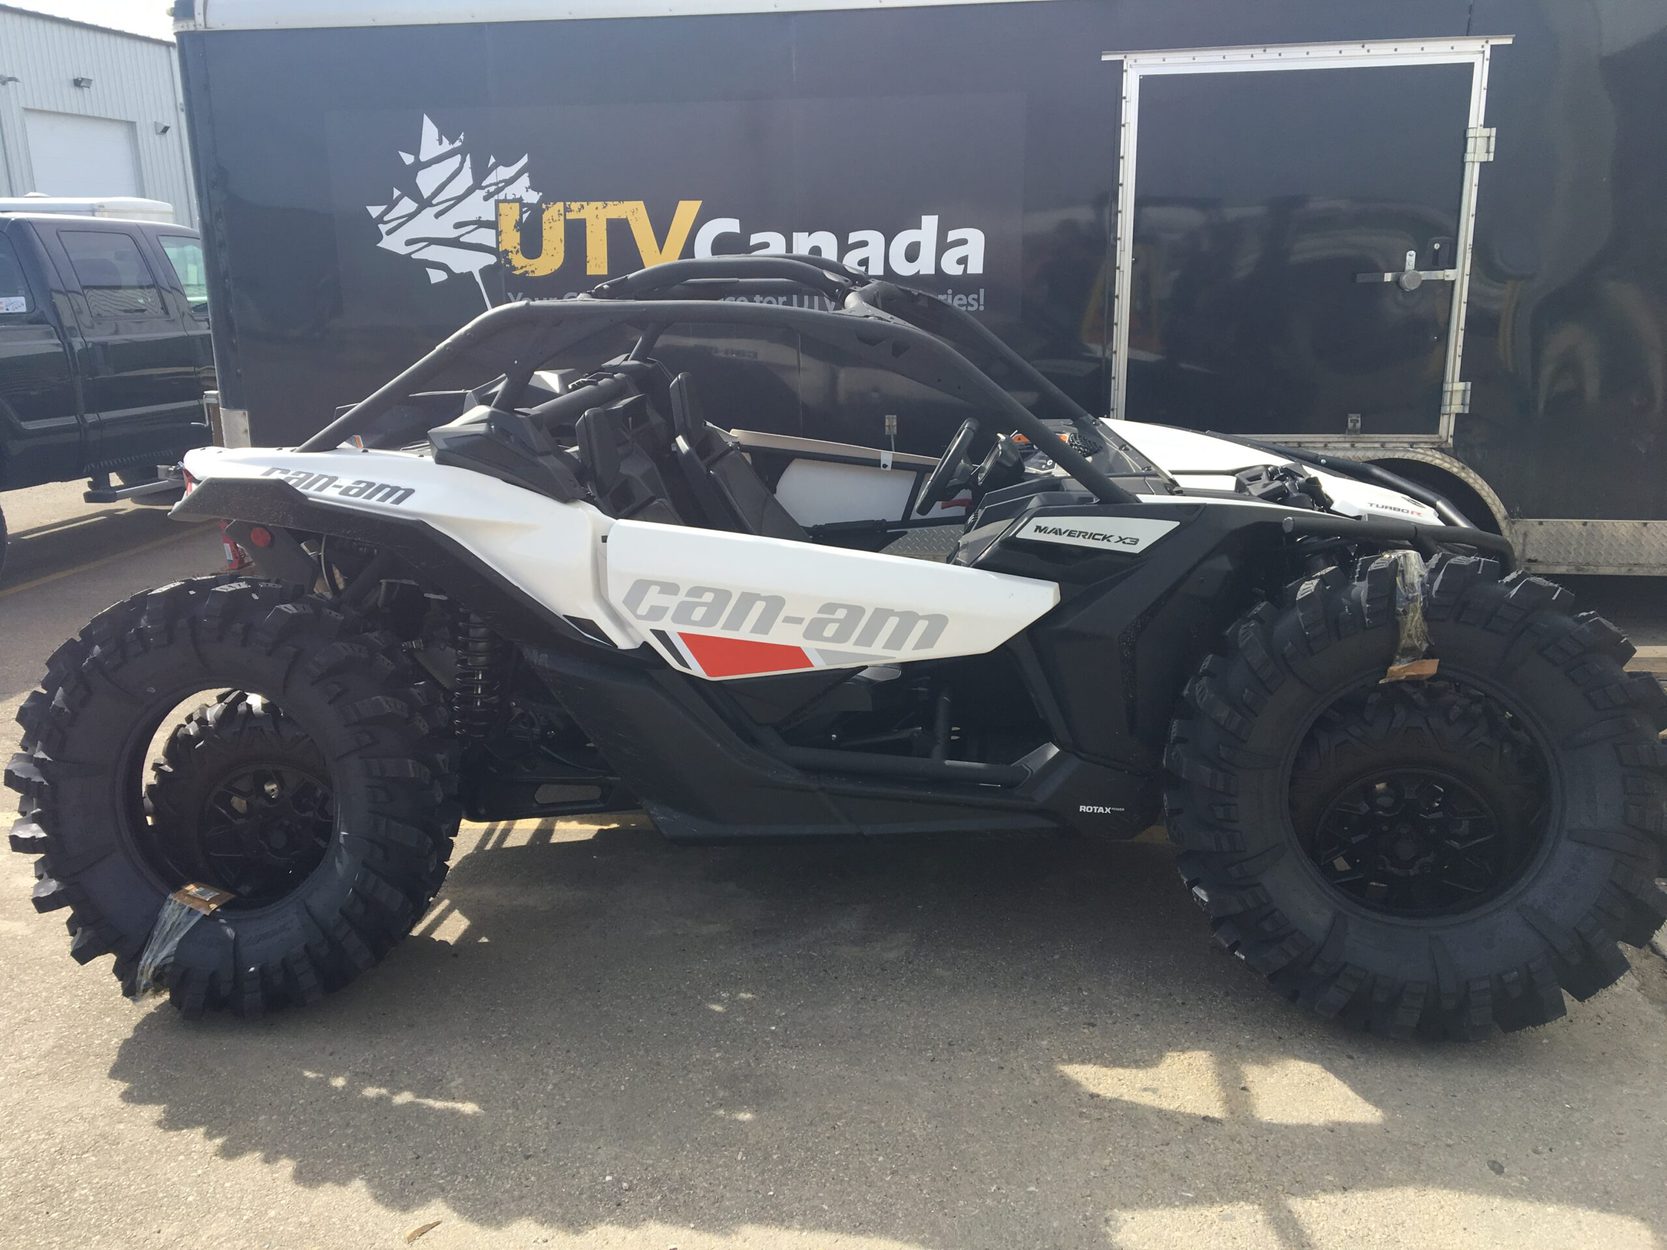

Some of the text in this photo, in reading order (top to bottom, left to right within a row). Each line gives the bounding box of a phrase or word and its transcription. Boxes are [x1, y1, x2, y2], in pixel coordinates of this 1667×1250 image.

[1034, 525, 1140, 546] MAVERICK X3
[622, 578, 949, 651] can-am
[1079, 805, 1111, 814] ROTAX
